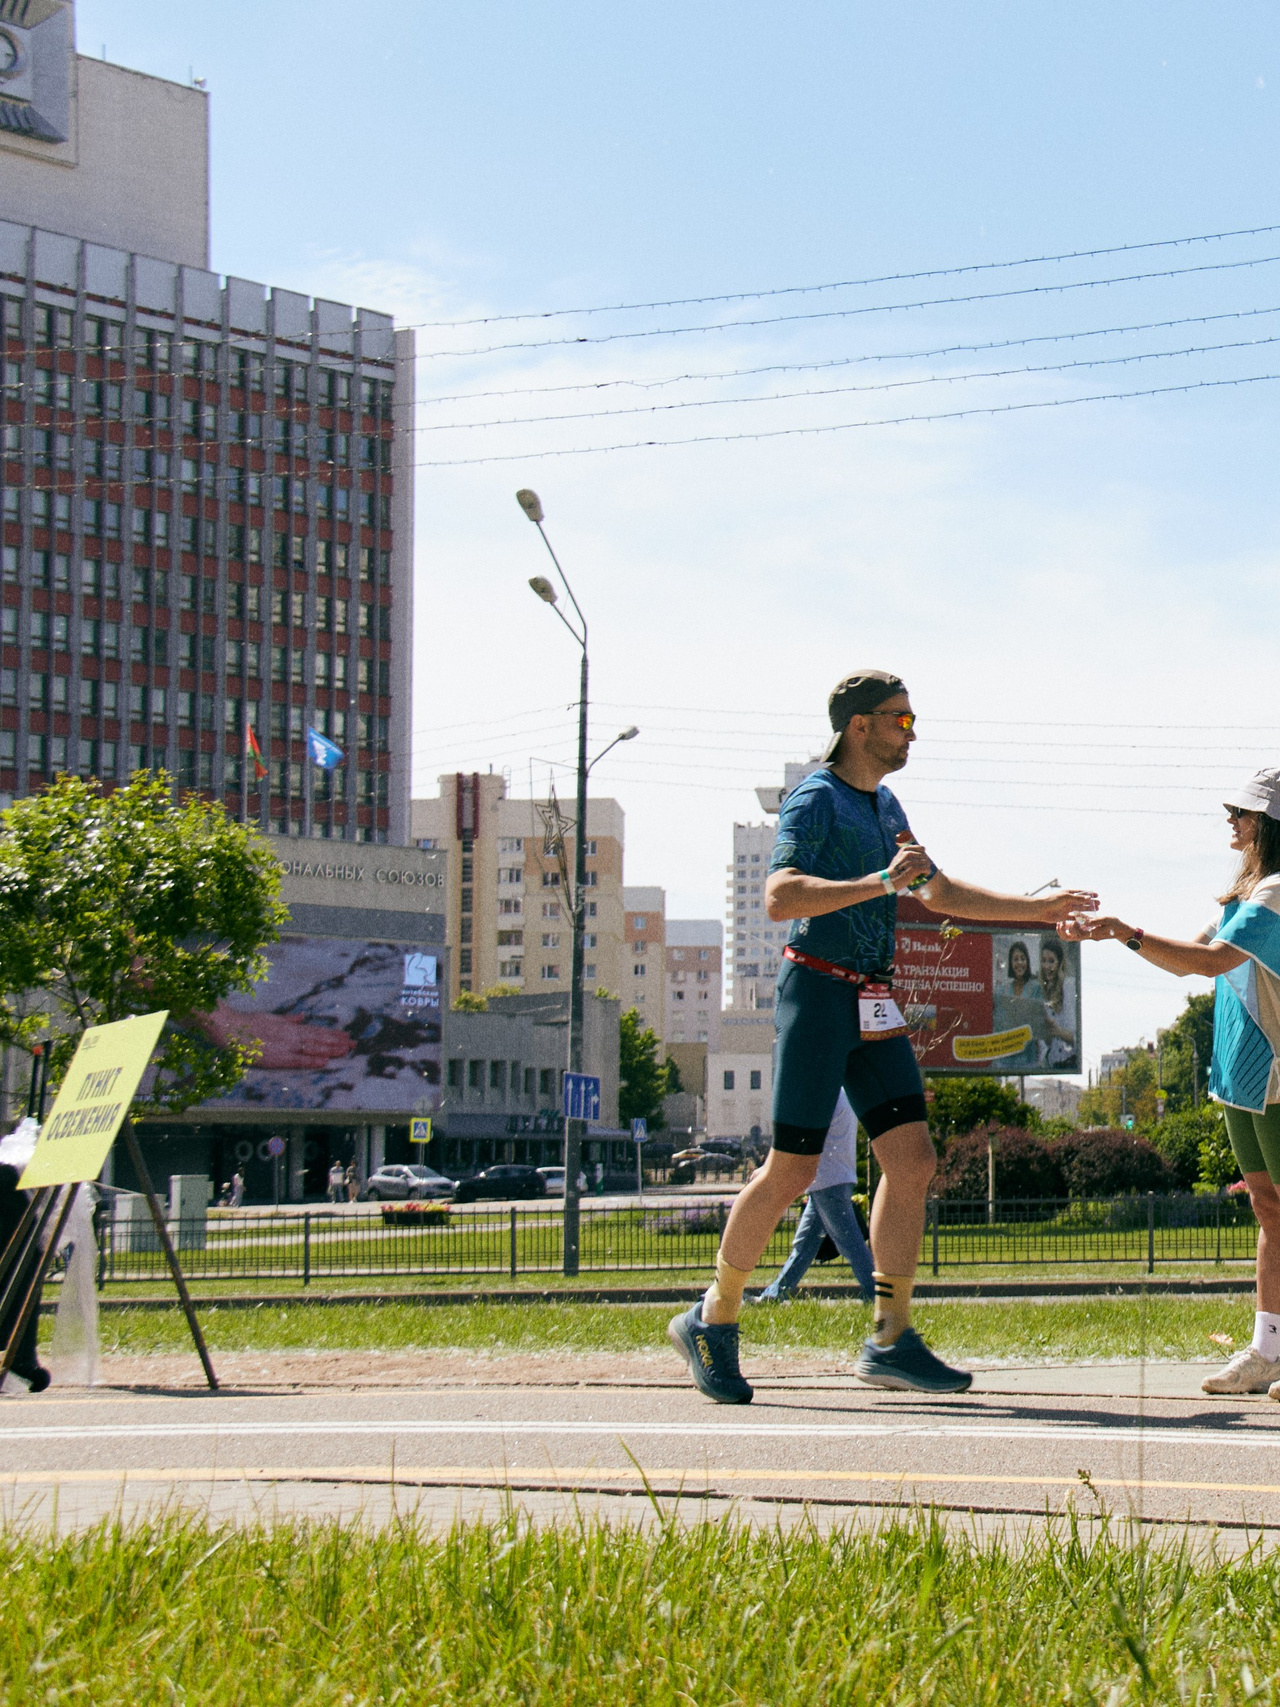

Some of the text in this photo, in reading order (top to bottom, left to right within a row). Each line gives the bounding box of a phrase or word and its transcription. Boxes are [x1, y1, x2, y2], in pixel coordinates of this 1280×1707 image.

[376, 869, 445, 887] СОЮЗОВ
[912, 941, 942, 952] Bank
[903, 965, 970, 978] ТРАНЗАКЦИЯ
[934, 981, 985, 993] УСПЕШНО!
[401, 996, 440, 1007] КОВРЫ
[77, 1067, 123, 1101] ПУНКТ
[47, 1102, 123, 1141] ОСВЕЖЕНИЯ
[695, 1334, 714, 1369] HOKA
